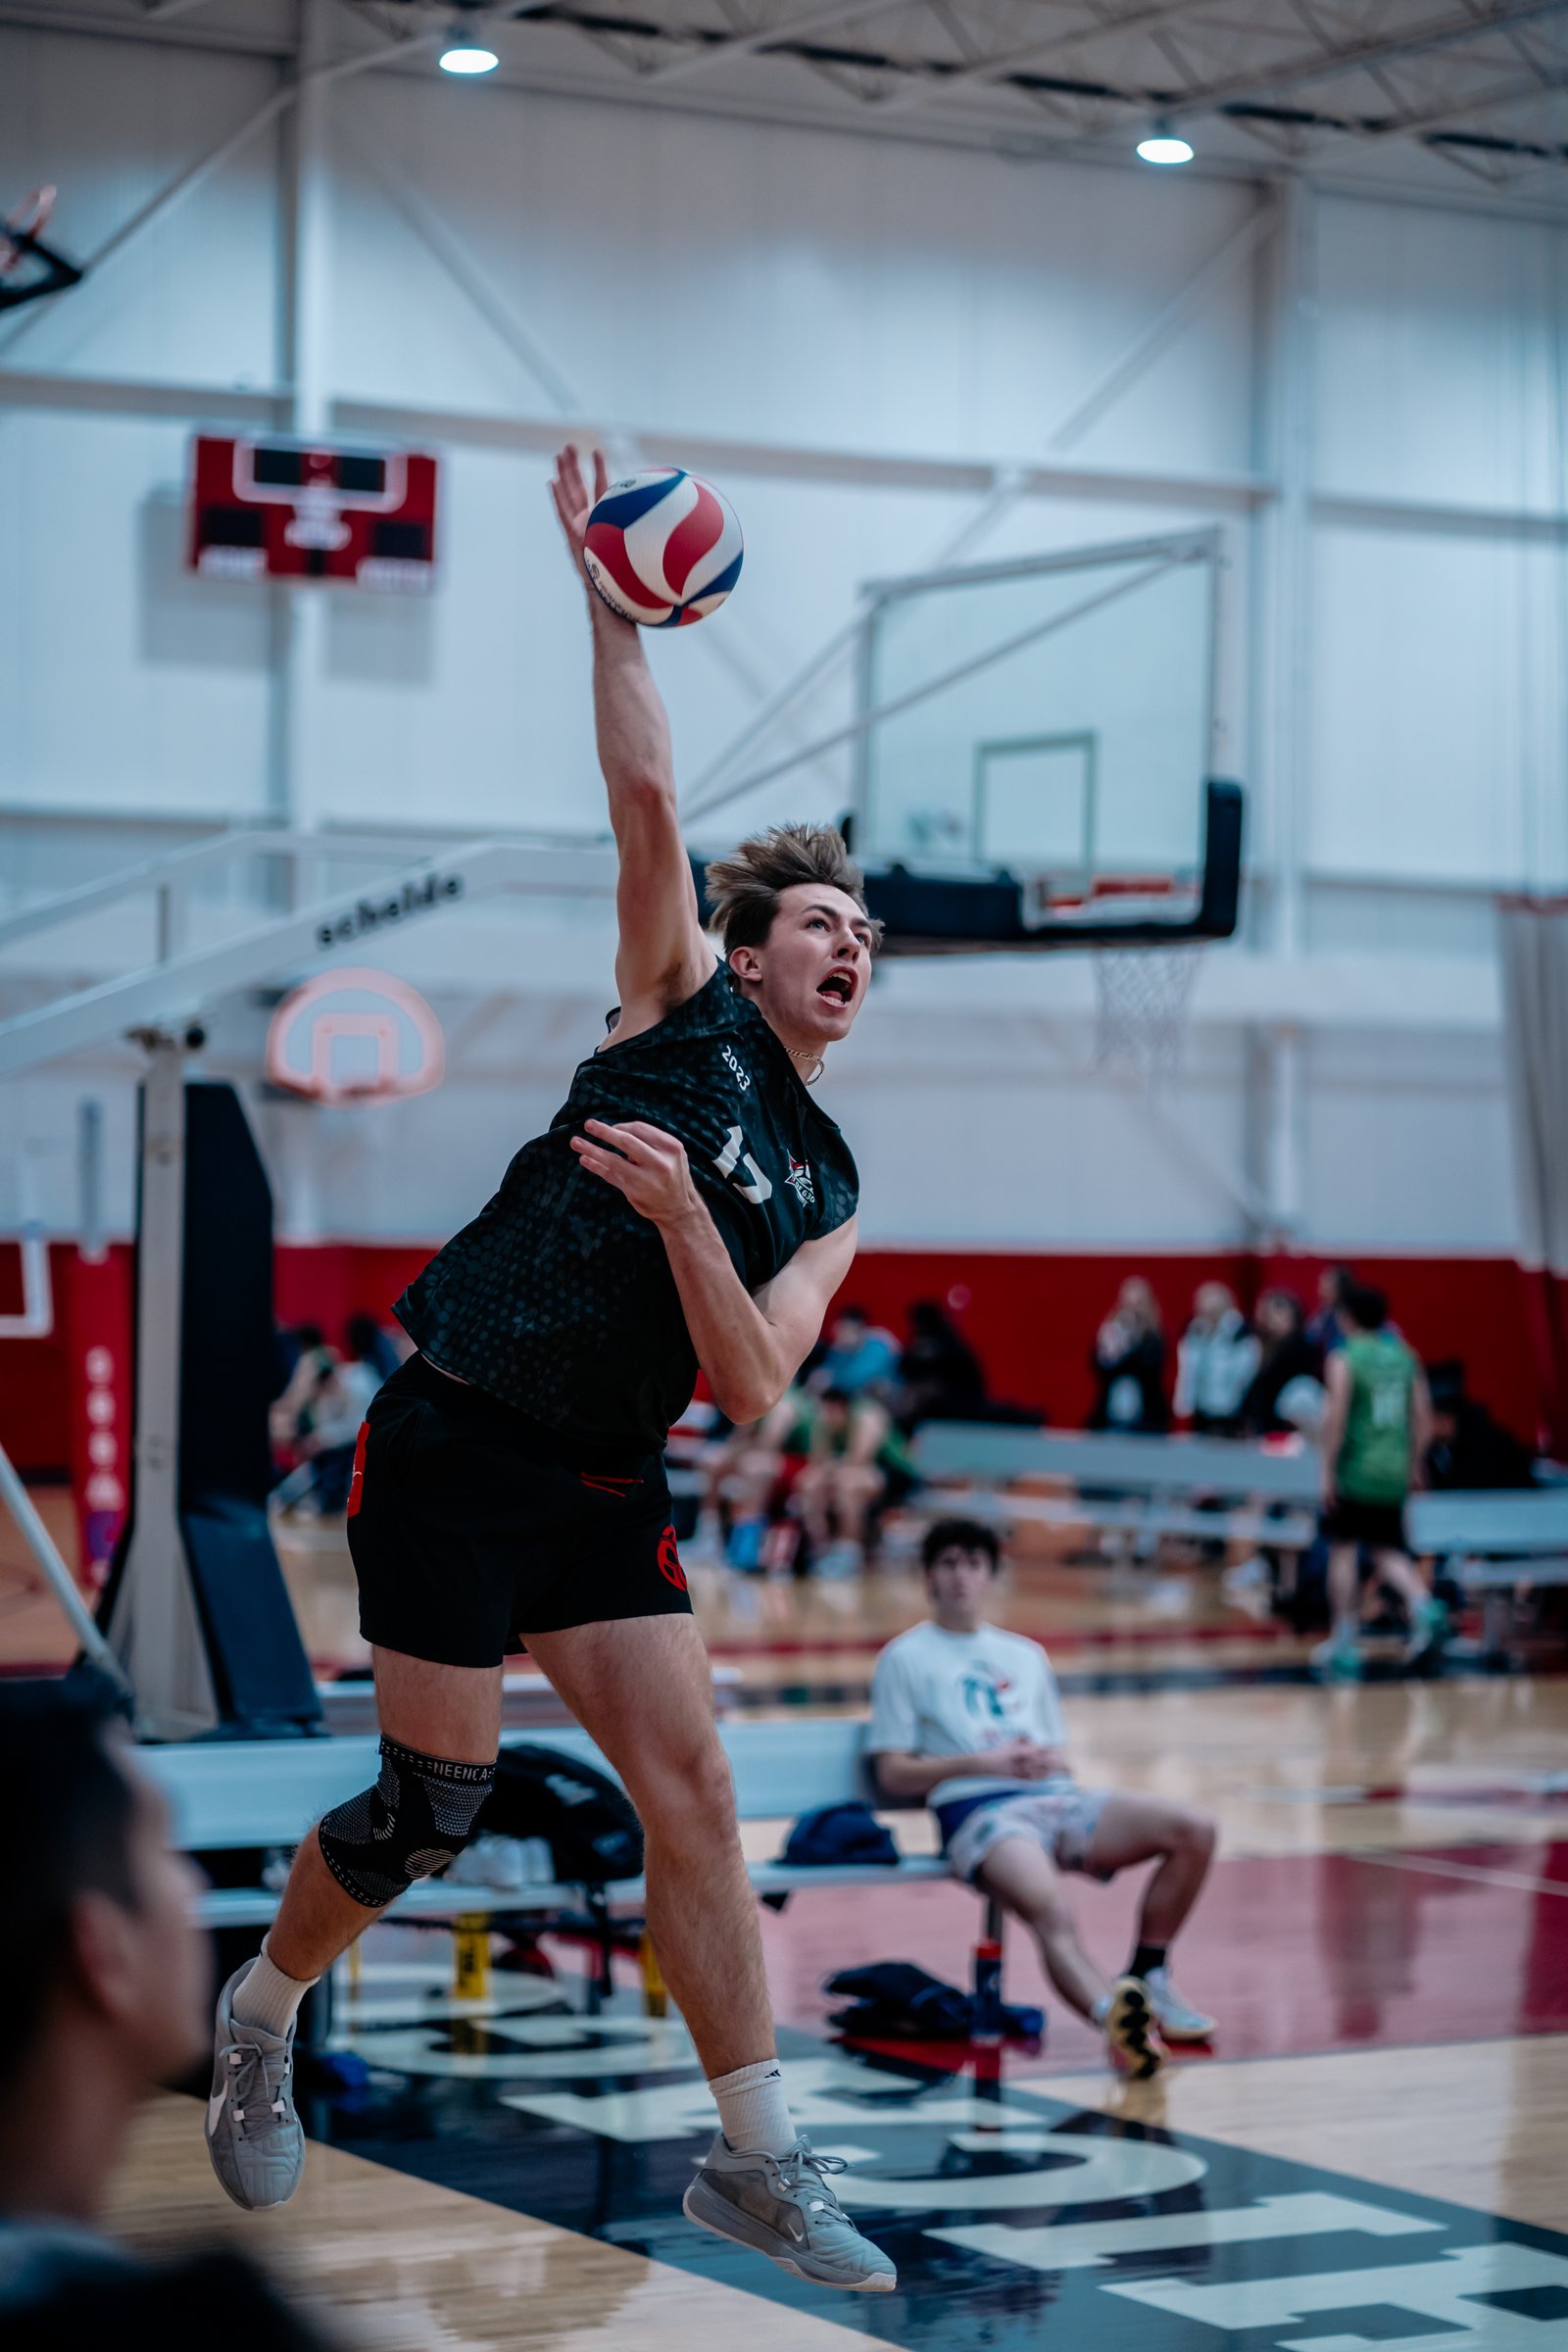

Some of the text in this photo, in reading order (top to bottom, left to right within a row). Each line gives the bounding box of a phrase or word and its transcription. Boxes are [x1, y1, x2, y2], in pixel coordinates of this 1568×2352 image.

[721, 1045, 751, 1091] 2023
[802, 1190, 815, 1203] 630
[433, 1761, 488, 1782] NEENCA
